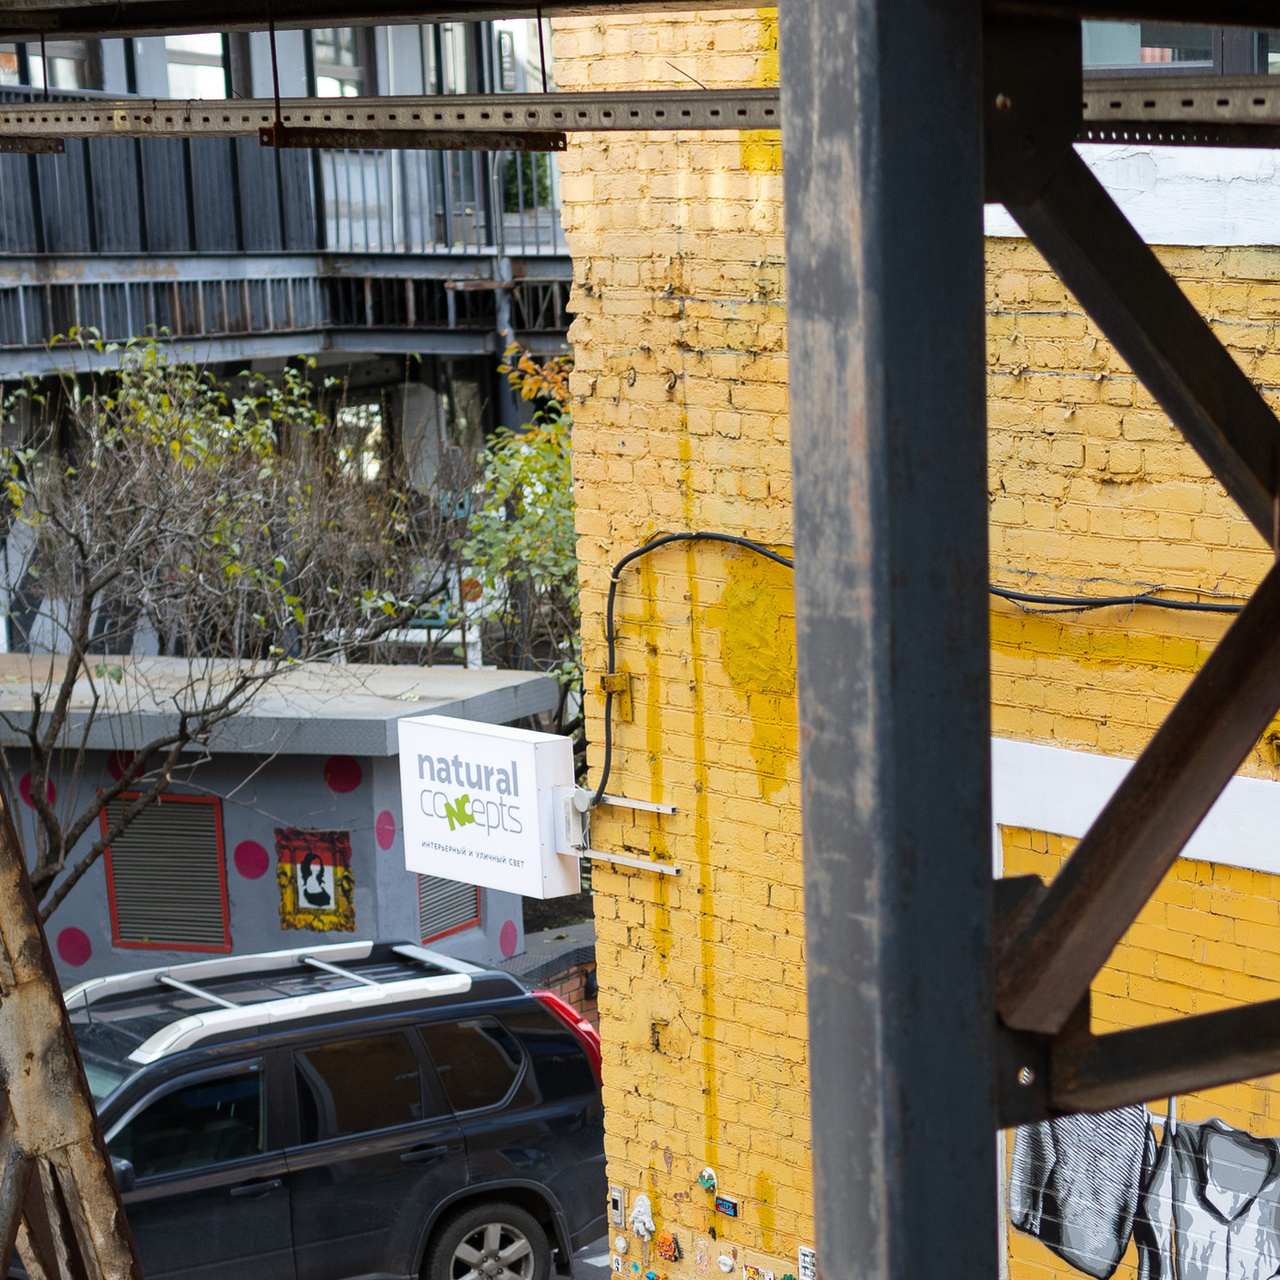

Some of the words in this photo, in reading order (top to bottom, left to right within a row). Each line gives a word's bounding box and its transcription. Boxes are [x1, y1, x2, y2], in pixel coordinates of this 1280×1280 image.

[417, 753, 520, 797] natural
[421, 840, 466, 856] ИНТЕРЬЕРНЫЙ
[475, 850, 507, 865] УЛИЧНЫЙ
[508, 858, 525, 868] СВЕТ
